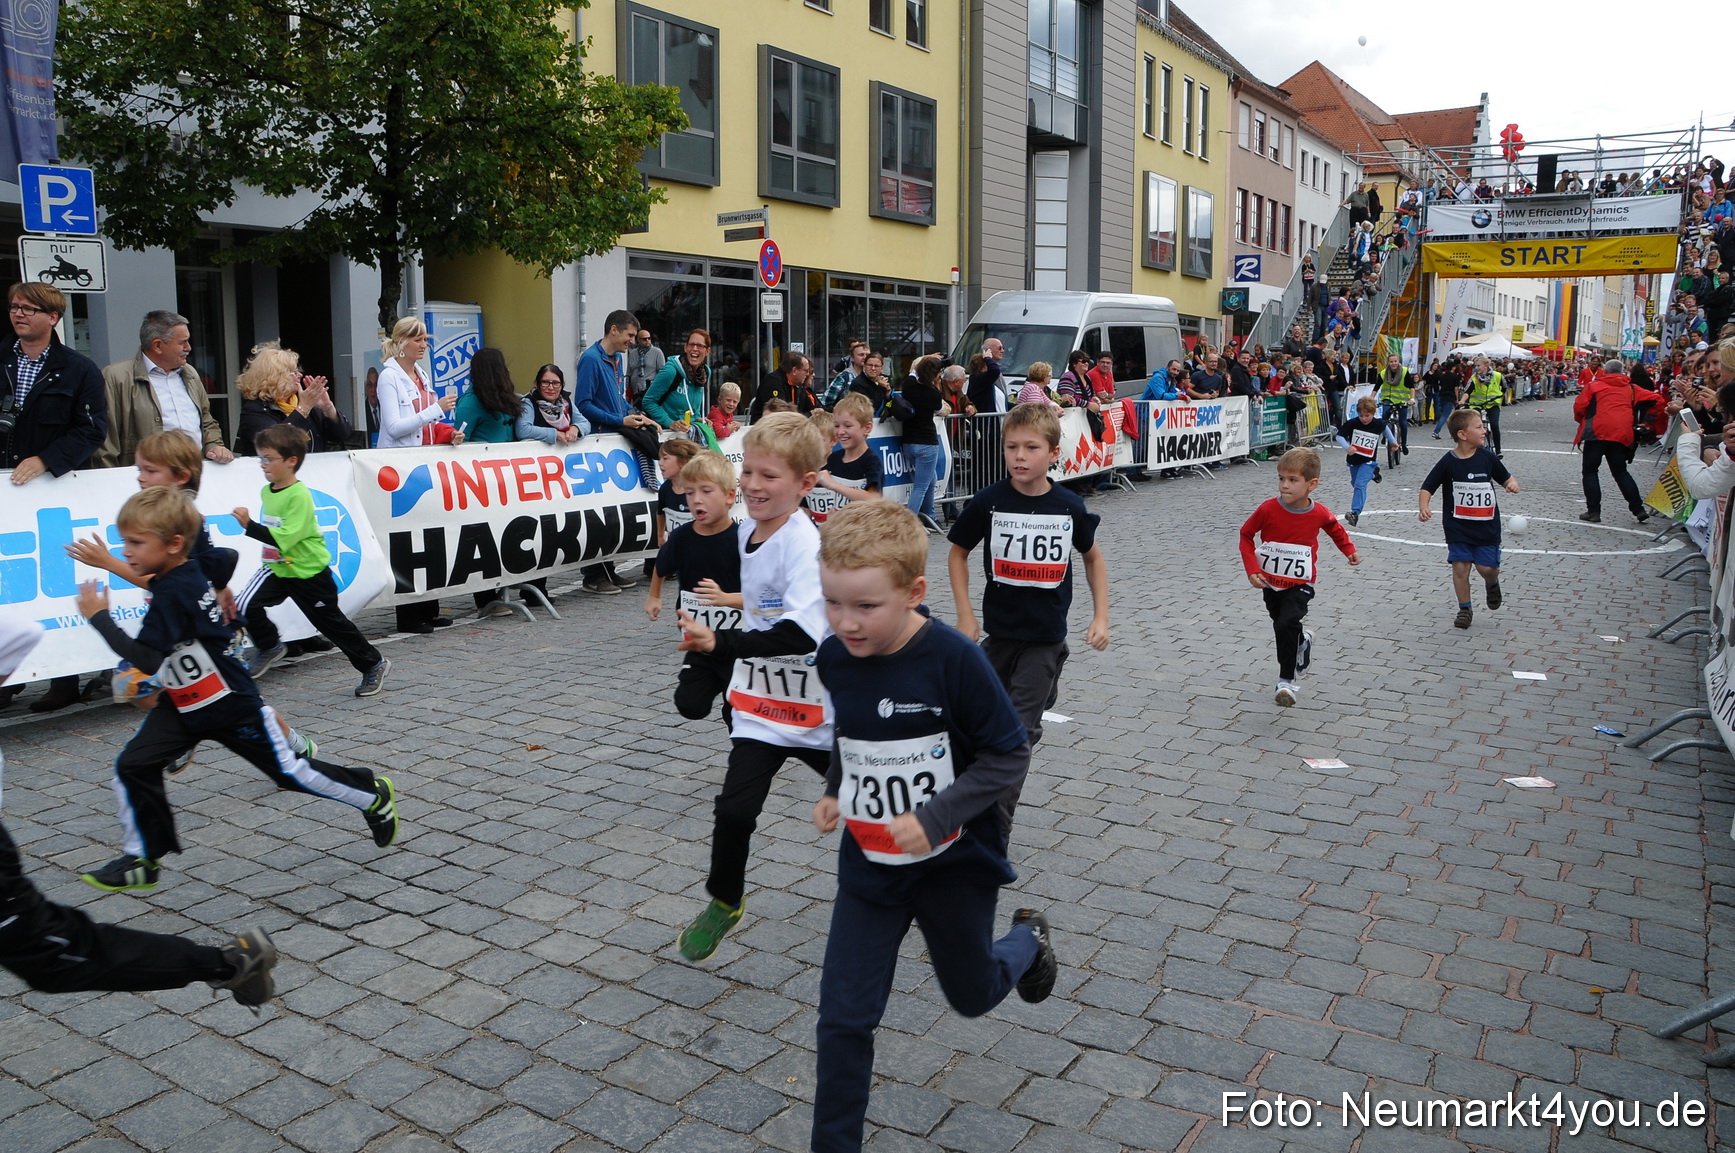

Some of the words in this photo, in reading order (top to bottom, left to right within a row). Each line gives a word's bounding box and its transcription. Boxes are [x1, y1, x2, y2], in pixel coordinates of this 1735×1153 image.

[38, 174, 77, 224] P
[1566, 217, 1585, 225] Mehr
[50, 243, 75, 254] nur
[1500, 245, 1587, 267] START
[1442, 323, 1452, 346] Audi
[1166, 404, 1222, 430] INTERSPORT
[1156, 431, 1222, 464] HACKNER
[1355, 435, 1375, 449] 7125
[1458, 492, 1492, 507] 7318
[993, 520, 1019, 529] PARTL
[1021, 522, 1060, 530] Neumarkt
[1000, 533, 1062, 562] 7165
[1275, 547, 1304, 556] Neumarkt
[1260, 553, 1306, 578] 7175
[741, 659, 809, 699] 7117
[752, 701, 801, 722] Jannik
[864, 751, 928, 768] Neumarkt
[850, 771, 938, 821] 7303
